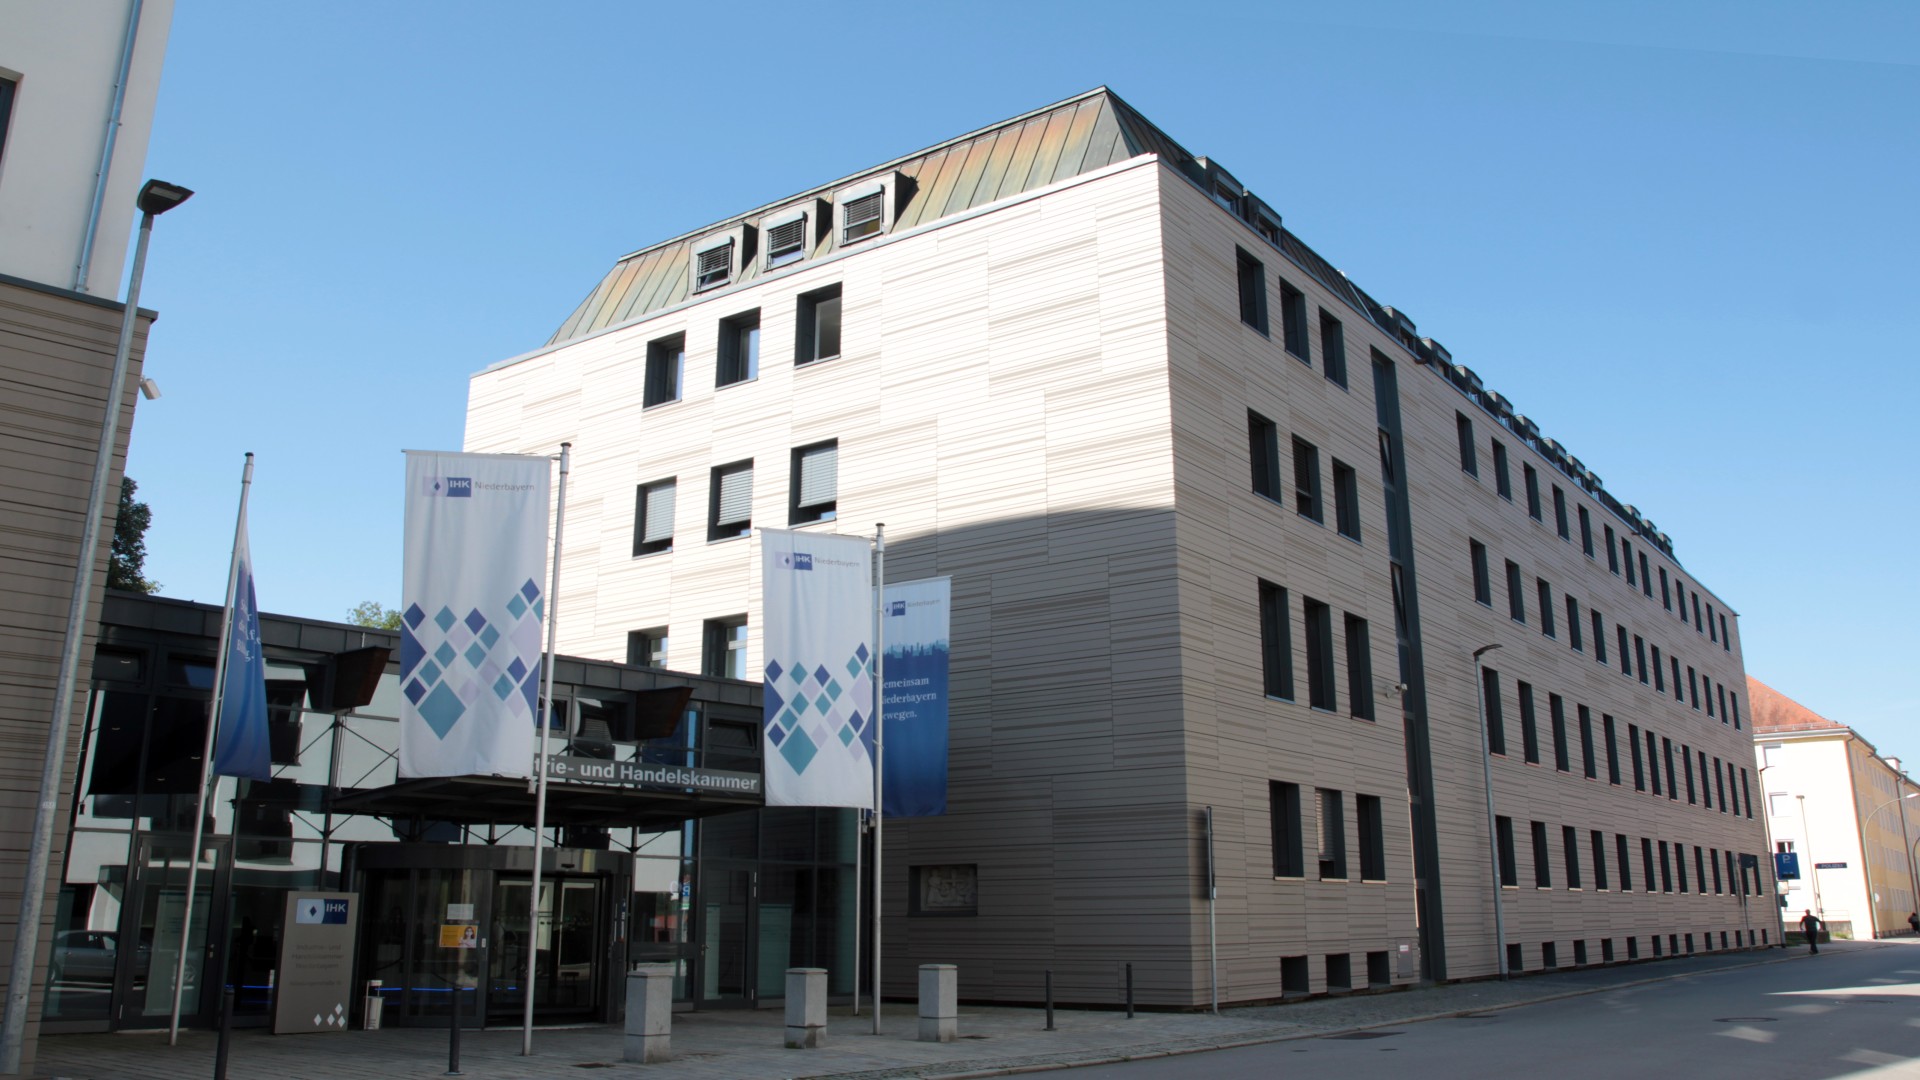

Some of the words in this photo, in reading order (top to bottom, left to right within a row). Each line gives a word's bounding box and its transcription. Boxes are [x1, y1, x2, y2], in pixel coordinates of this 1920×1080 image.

[449, 480, 470, 489] IHK
[475, 481, 534, 491] Niederbayern
[795, 555, 812, 564] IHK
[814, 556, 860, 568] Niederbayern
[882, 677, 929, 689] emeinsam
[882, 692, 937, 704] iederbayern
[882, 710, 918, 722] ewegen.
[580, 763, 615, 779] und
[620, 765, 758, 790] Handelskammer
[326, 903, 346, 913] IHK
